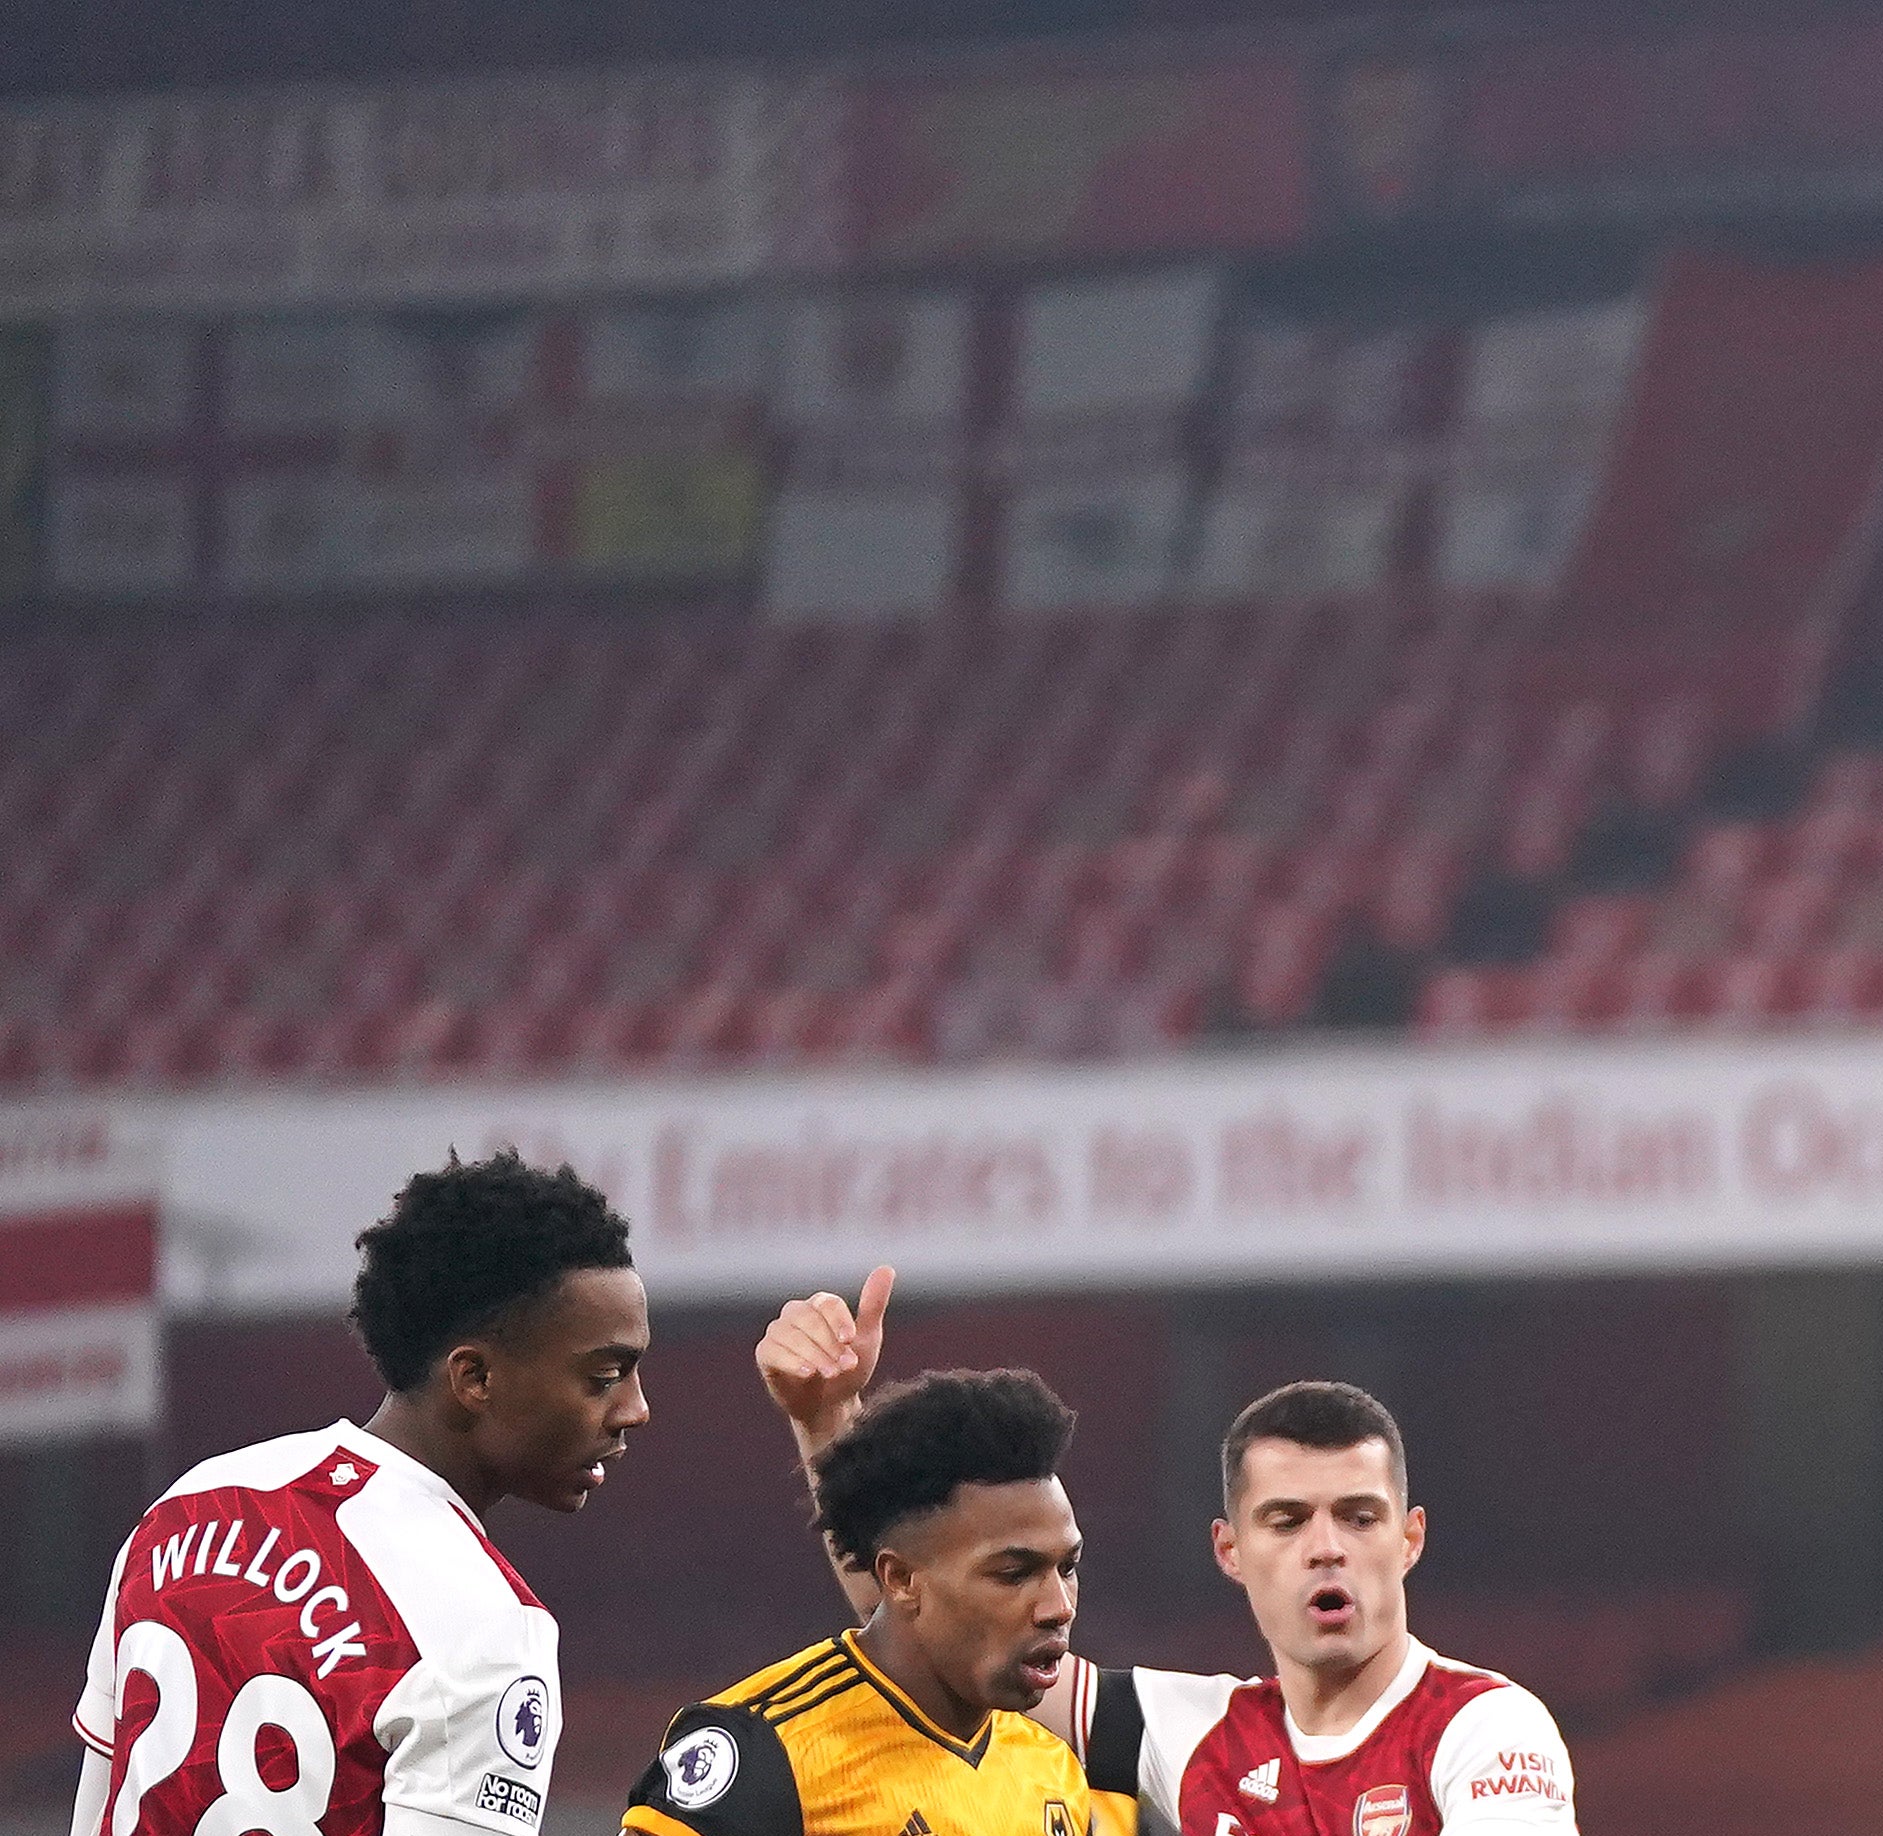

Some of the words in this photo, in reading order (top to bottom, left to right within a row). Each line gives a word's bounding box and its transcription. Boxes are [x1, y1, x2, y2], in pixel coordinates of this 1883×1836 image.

[647, 1108, 1064, 1245] Emirates
[1086, 1110, 1192, 1230] to
[1214, 1095, 1366, 1215] the
[1400, 1075, 1716, 1205] Indian
[151, 1519, 366, 1679] WILLOCK
[1497, 1750, 1556, 1776] VISIT
[482, 1774, 510, 1796] No
[1237, 1776, 1280, 1805] adidas
